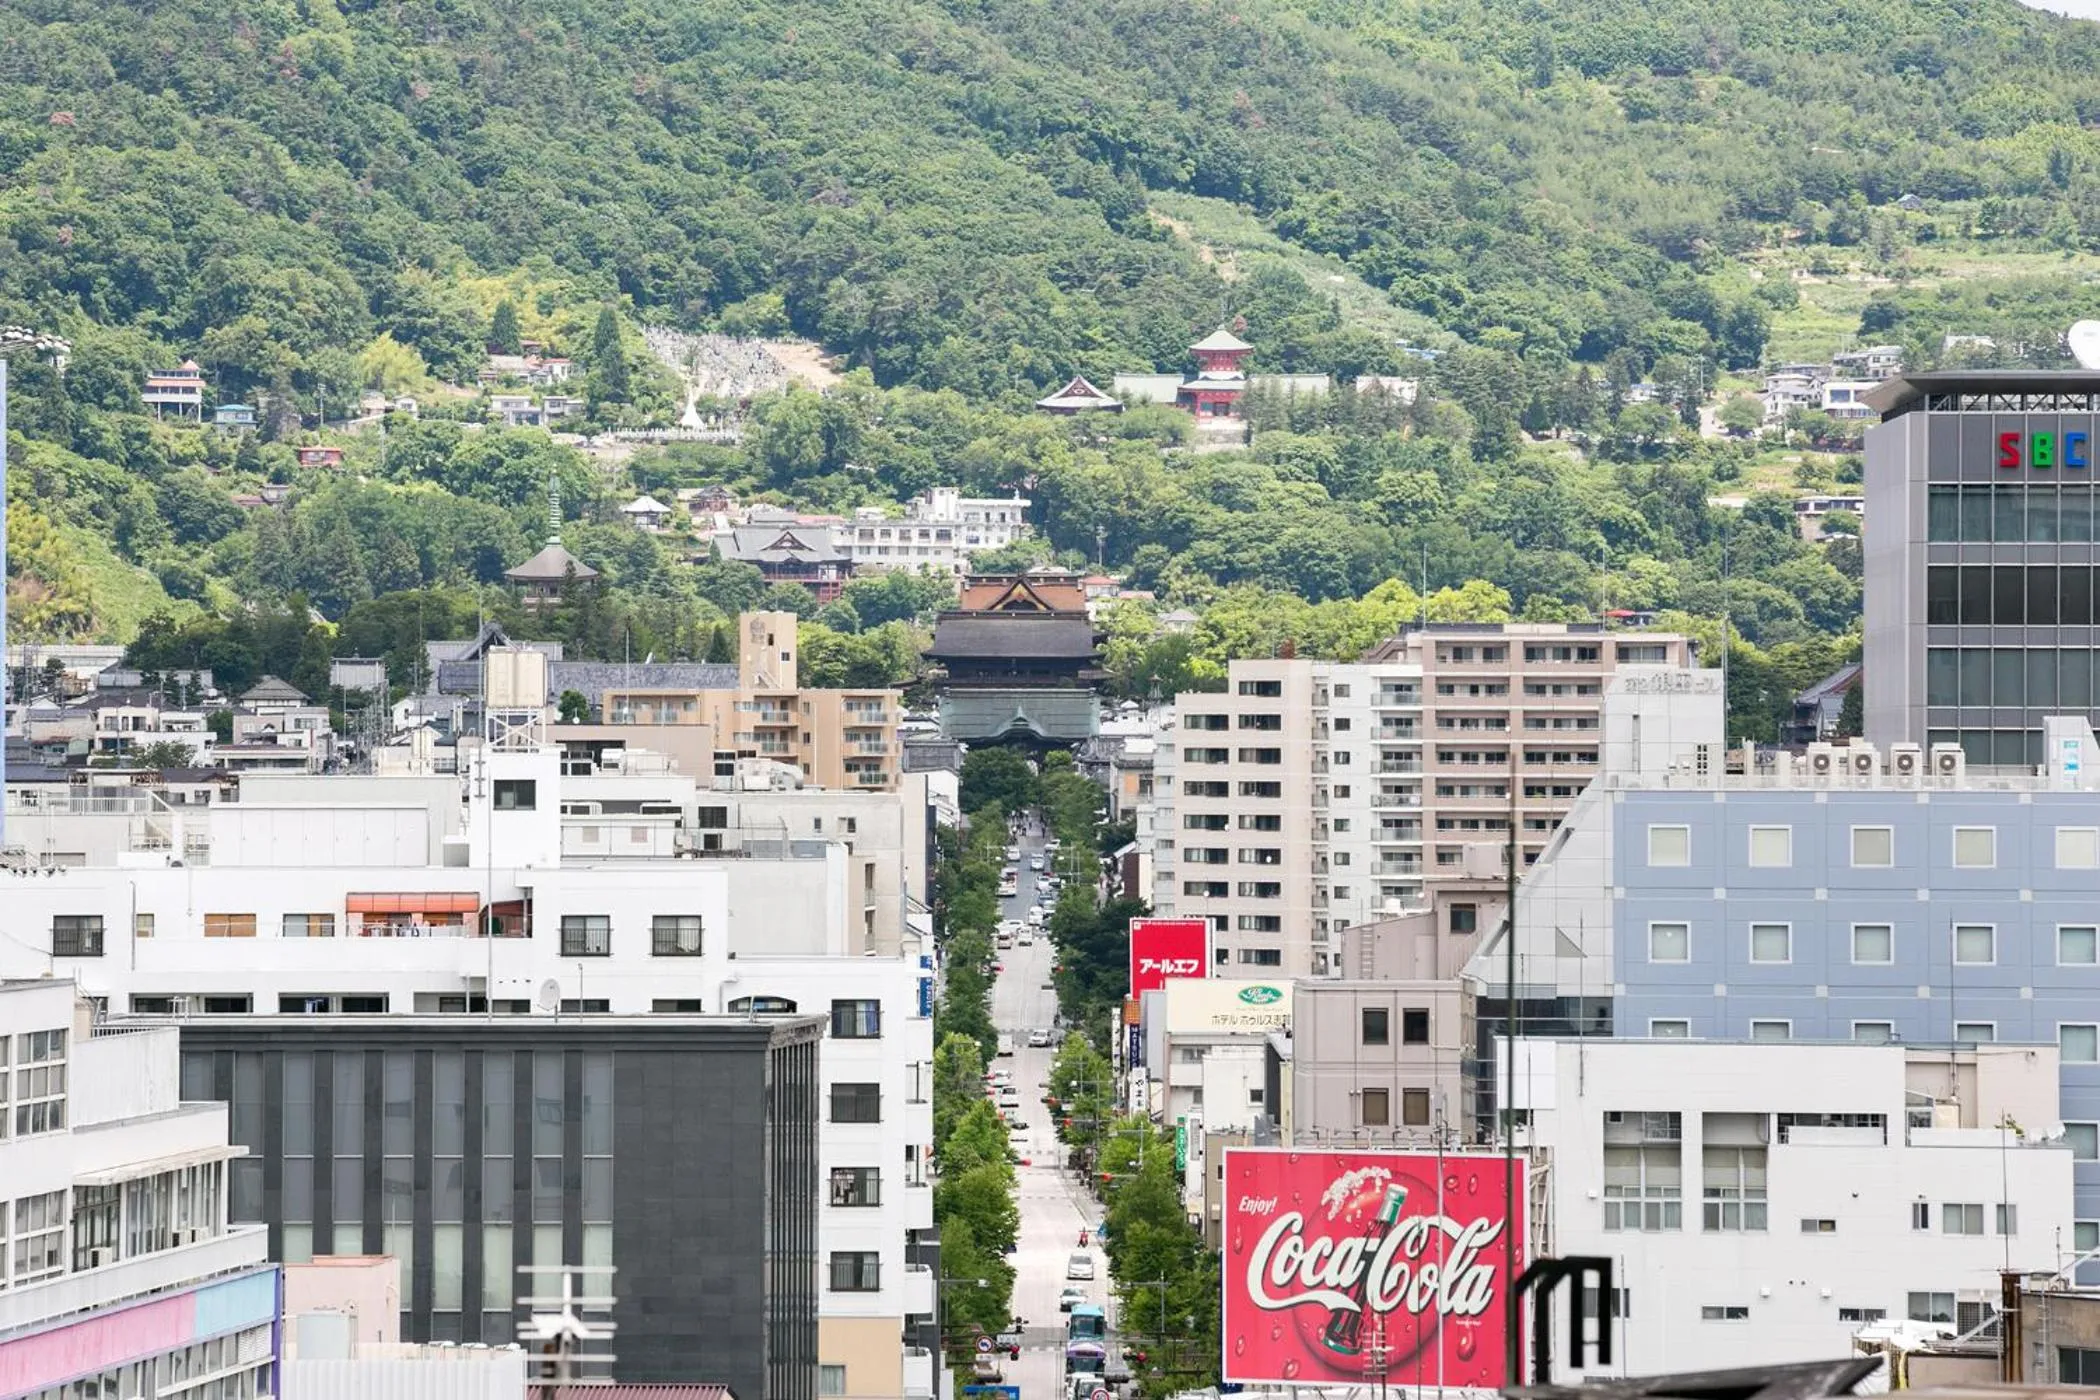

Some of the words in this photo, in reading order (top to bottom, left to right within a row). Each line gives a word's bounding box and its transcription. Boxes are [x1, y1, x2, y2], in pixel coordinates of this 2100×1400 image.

[2000, 432, 2088, 467] SBC
[1140, 958, 1199, 974] アールエフ
[1239, 1196, 1278, 1215] Enjoy!
[1247, 1211, 1504, 1315] Coca-Cola
